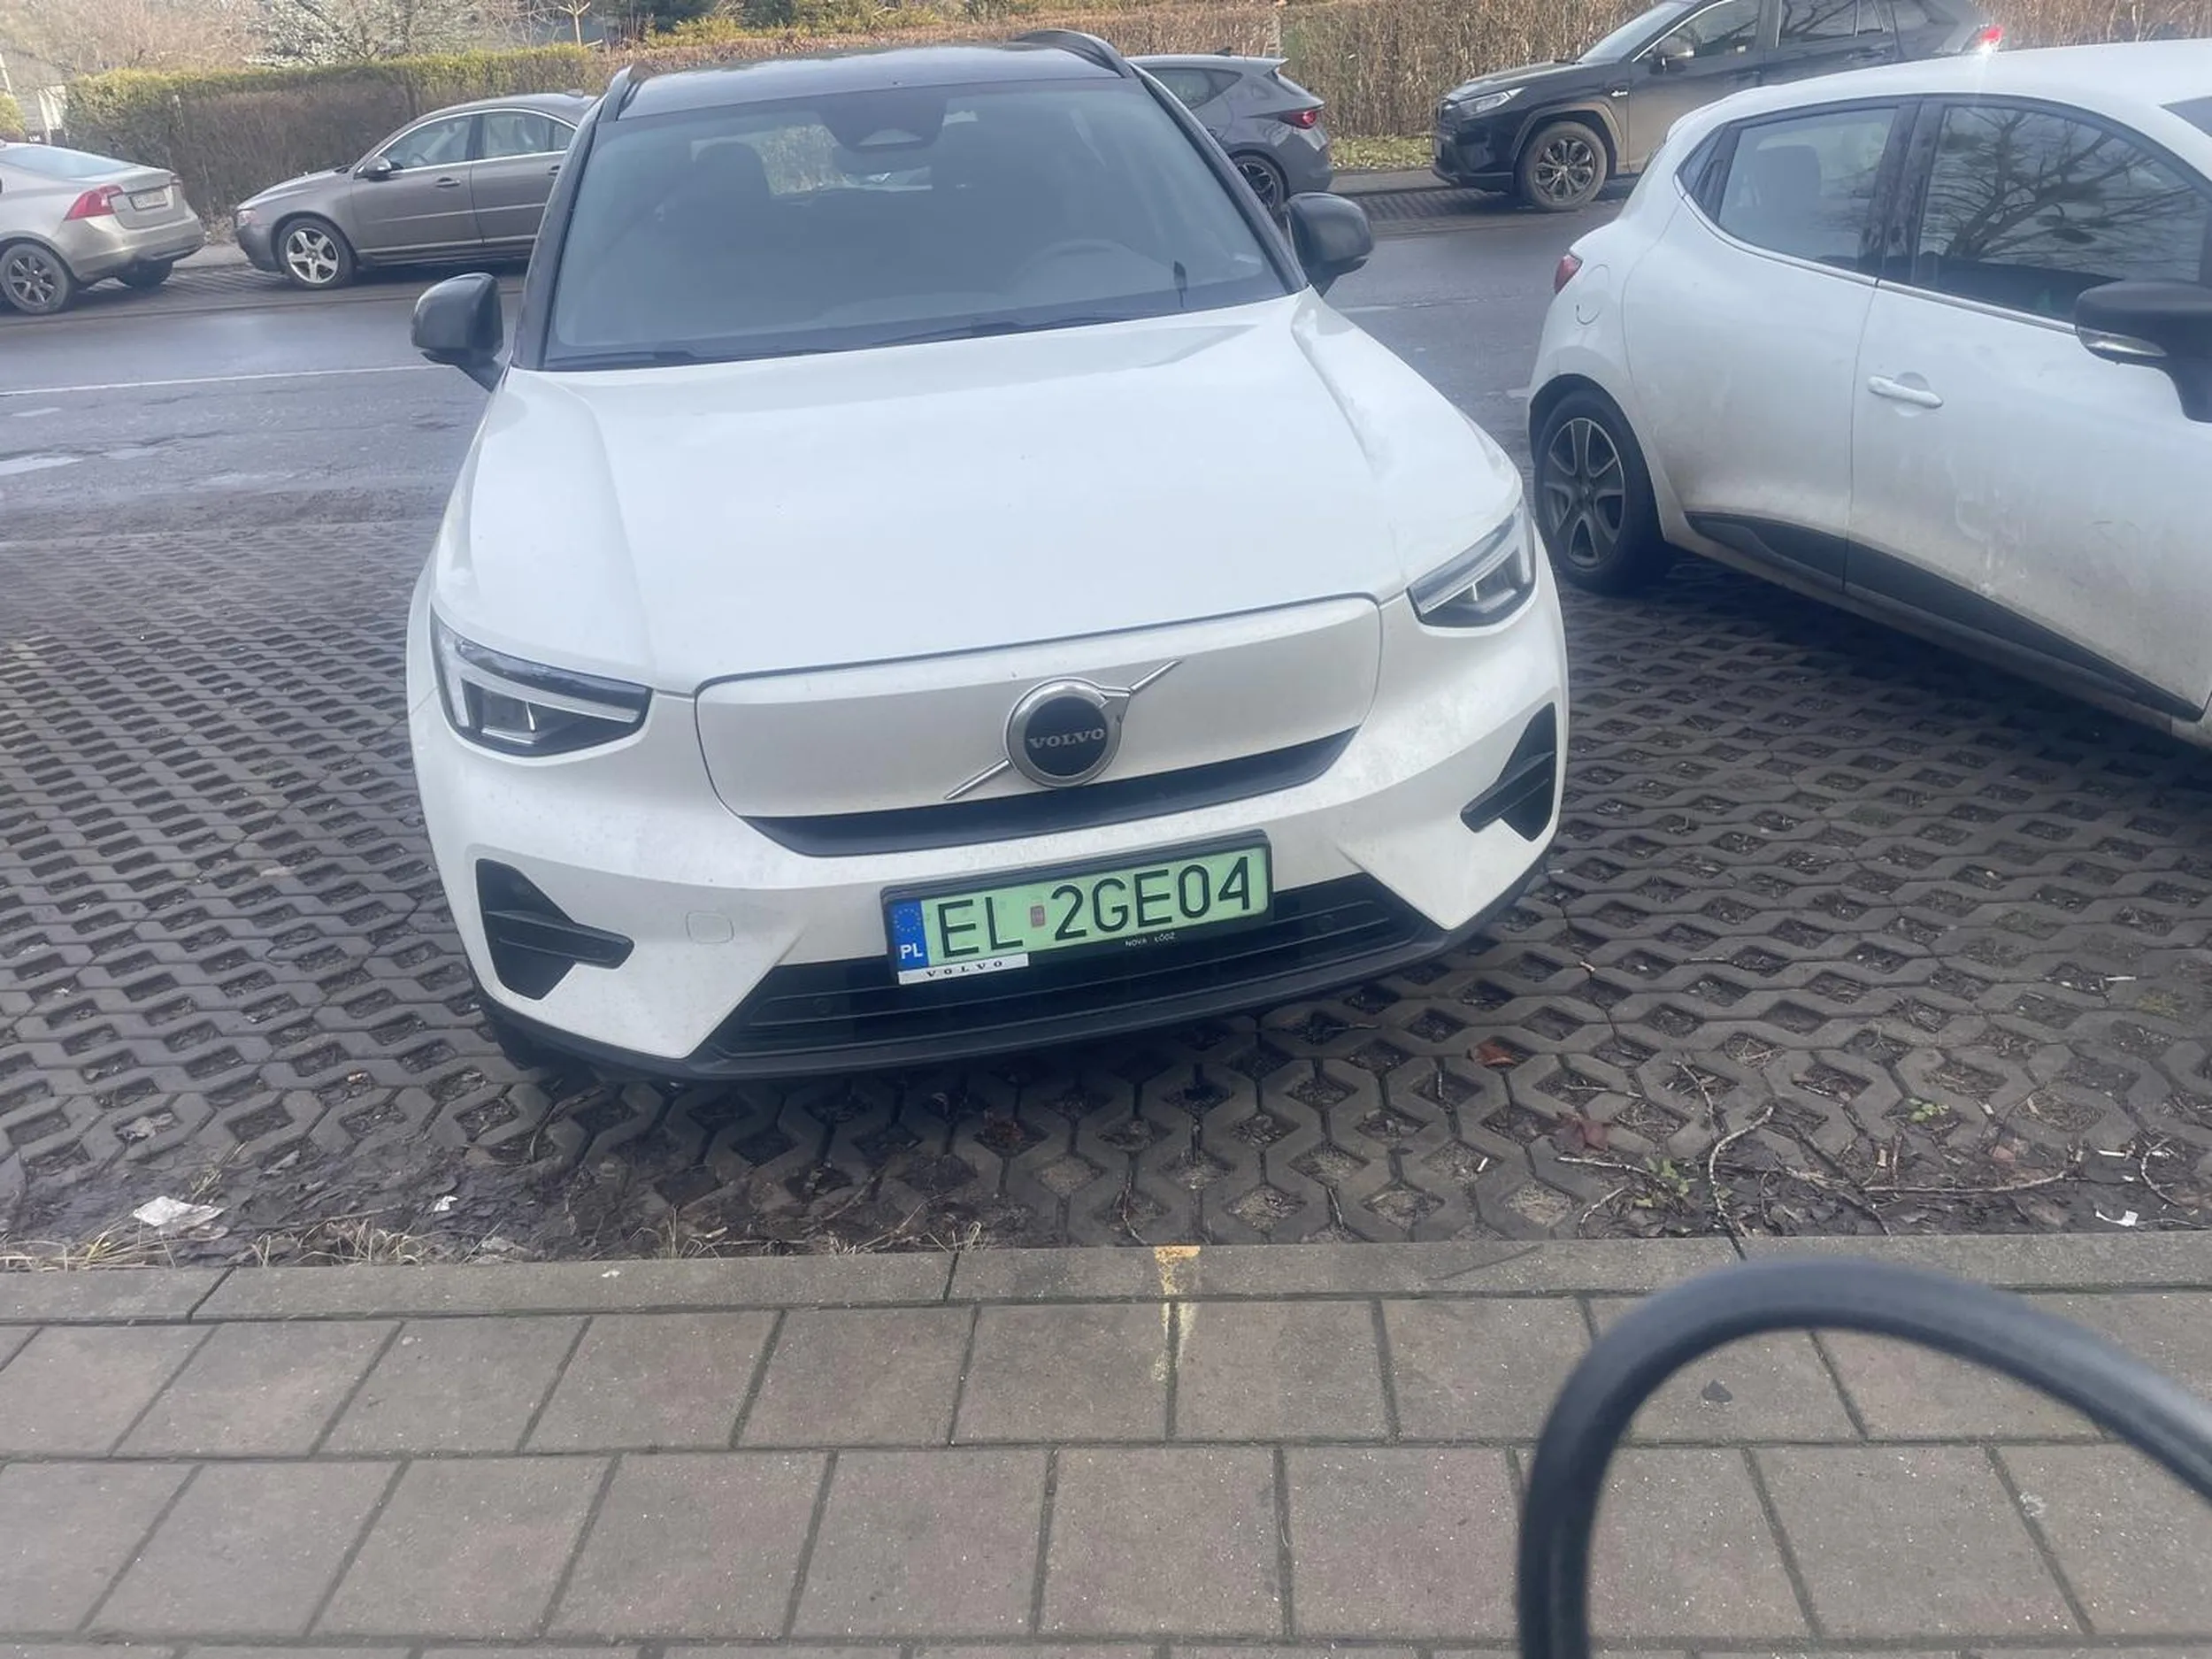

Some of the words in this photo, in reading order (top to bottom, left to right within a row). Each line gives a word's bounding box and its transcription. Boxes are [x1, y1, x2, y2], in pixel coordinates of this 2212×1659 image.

[1029, 728, 1105, 749] VOLVO
[938, 896, 1023, 958] EL
[1050, 856, 1250, 941] 2GE04
[900, 943, 923, 959] PL
[926, 960, 1002, 978] VOLVO
